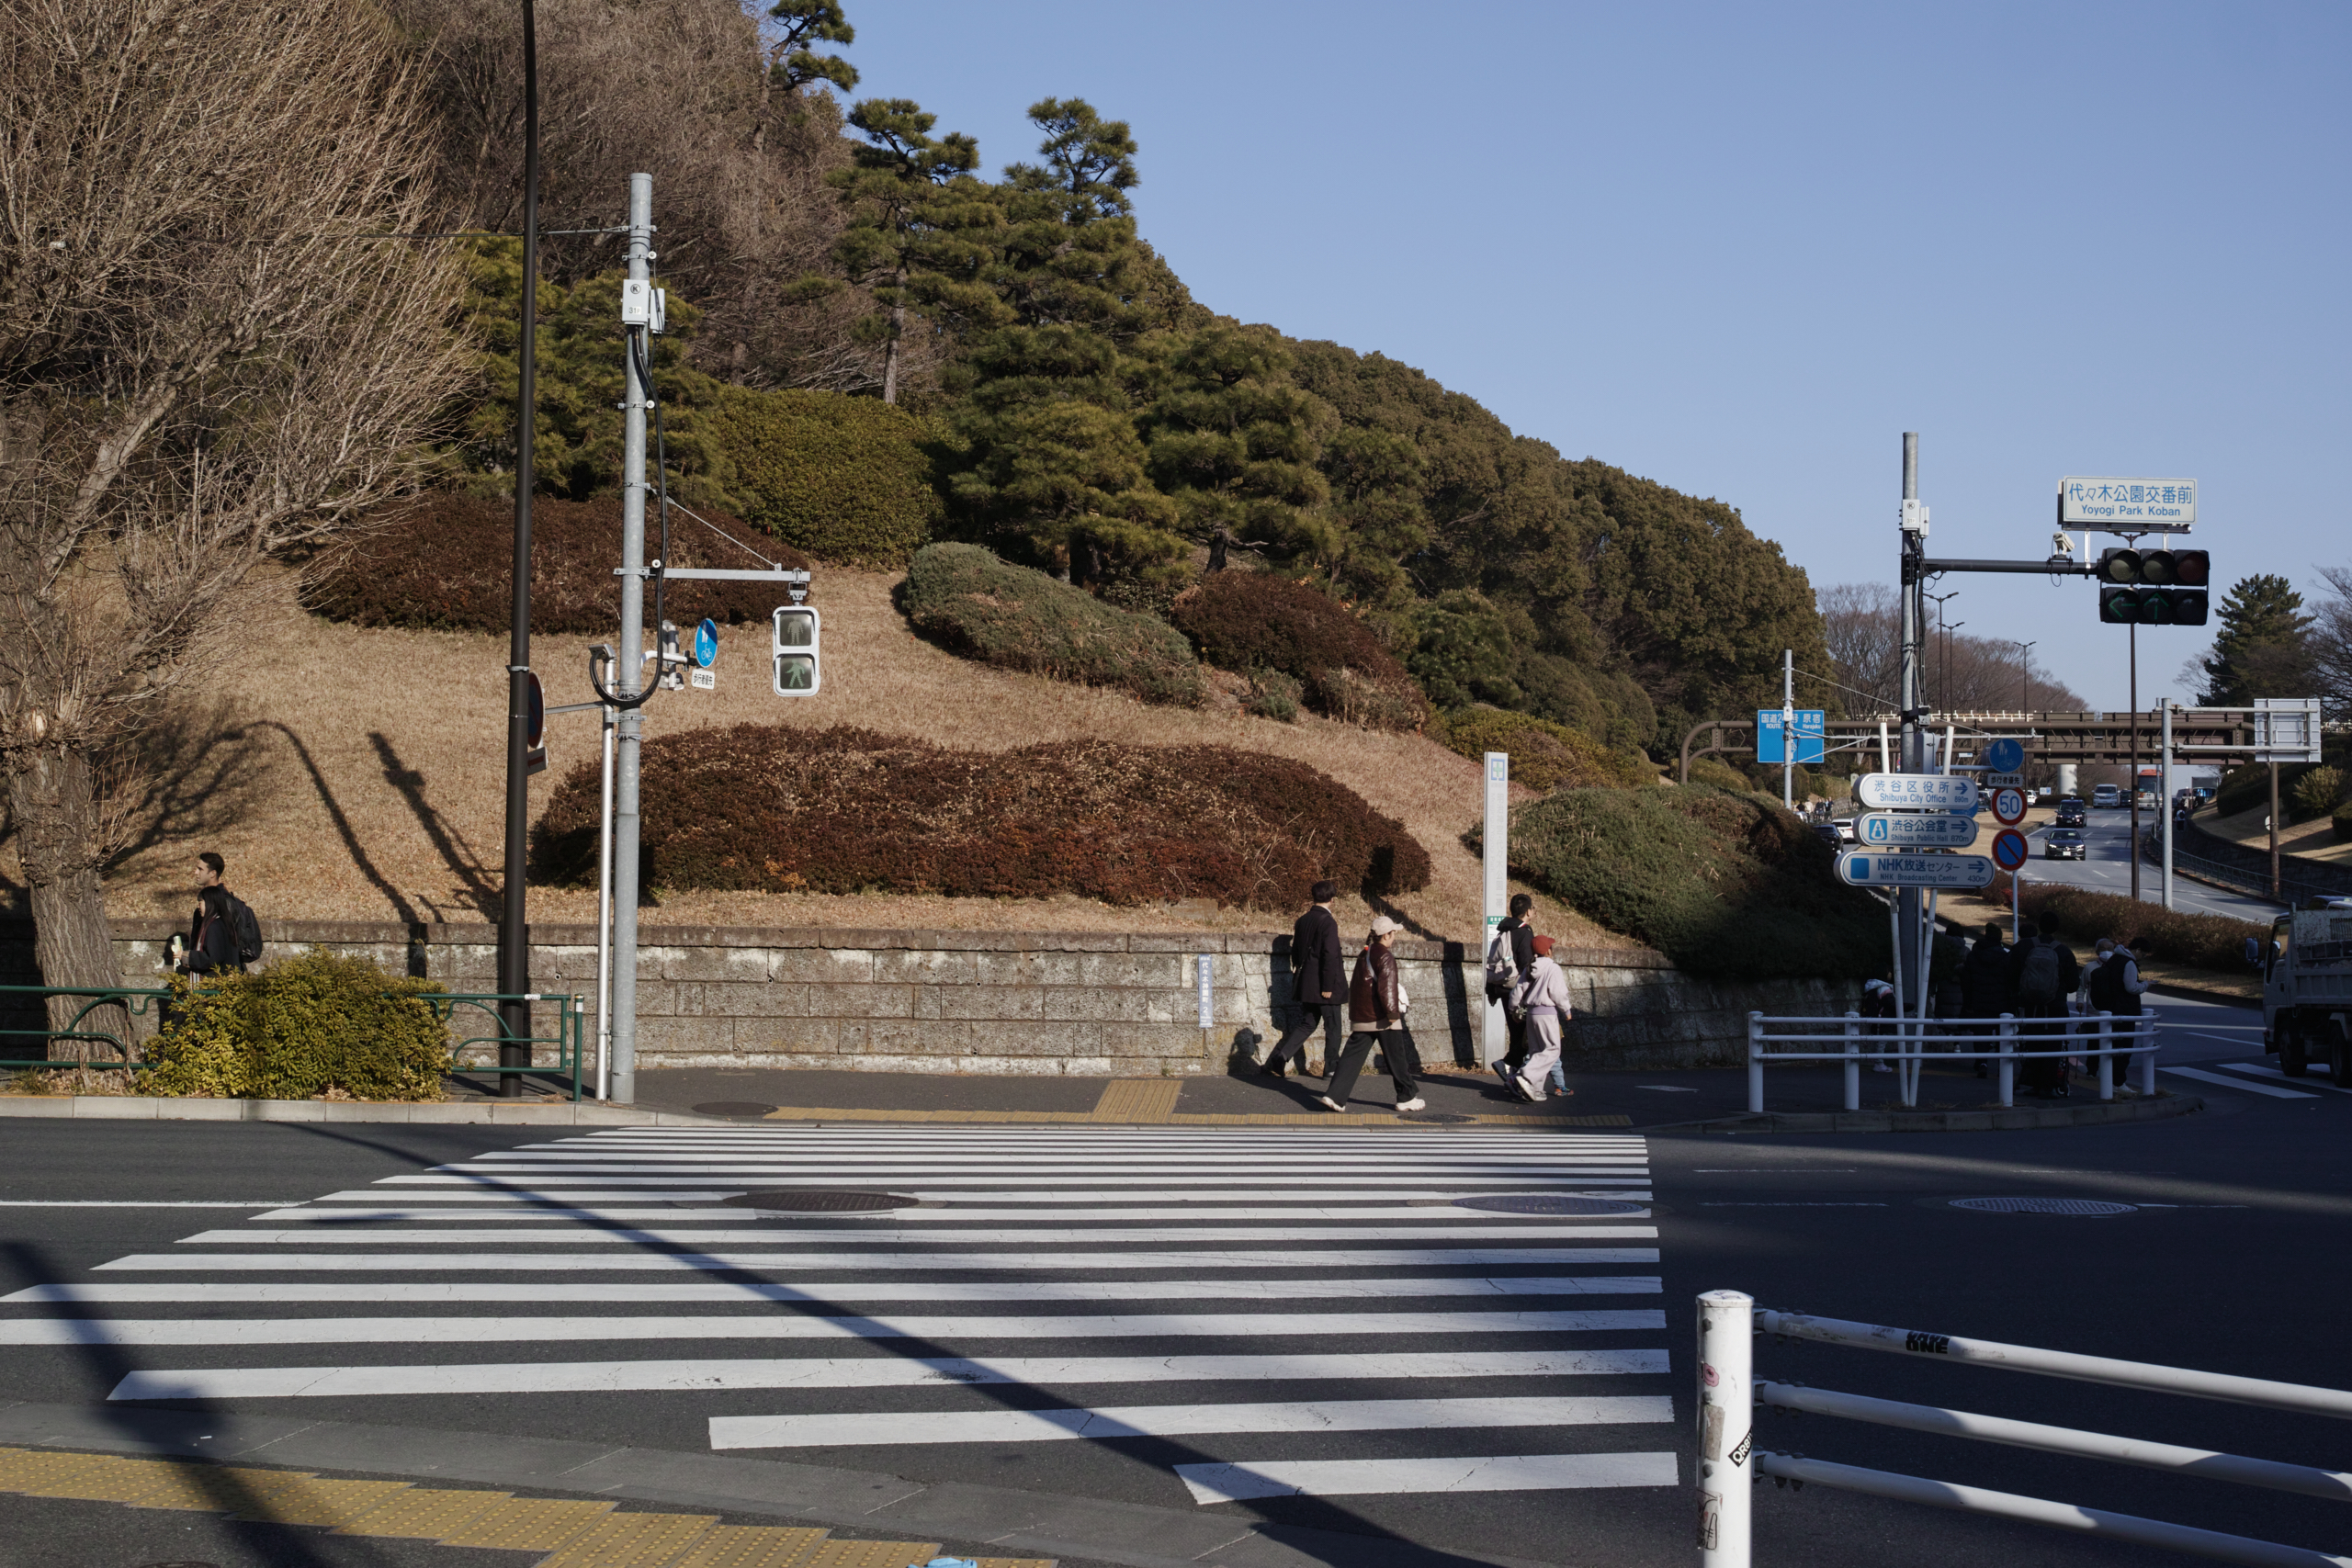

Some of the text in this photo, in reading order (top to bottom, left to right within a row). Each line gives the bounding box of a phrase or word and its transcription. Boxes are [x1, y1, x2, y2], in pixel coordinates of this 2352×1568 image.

[2068, 482, 2193, 504] 代々木公園交番前
[2081, 504, 2181, 516] Yoyogi Park Koban
[1803, 713, 1821, 724] 原宿
[1990, 775, 2020, 785] 歩行者優先
[1874, 779, 1950, 794] 渋谷区役所
[1880, 793, 1947, 805] Shibuya City Office
[1954, 795, 1969, 804] 890m
[1999, 795, 2019, 815] 50
[1891, 818, 1948, 833] 渋谷公会堂
[1890, 833, 1949, 843] Shibuya Public Hall
[1951, 835, 1970, 843] 870m
[1877, 857, 1961, 873] NHK放送センター
[1897, 874, 1937, 883] Broadcasting
[1967, 875, 1986, 884] 430m
[1905, 1339, 1948, 1354] ONE
